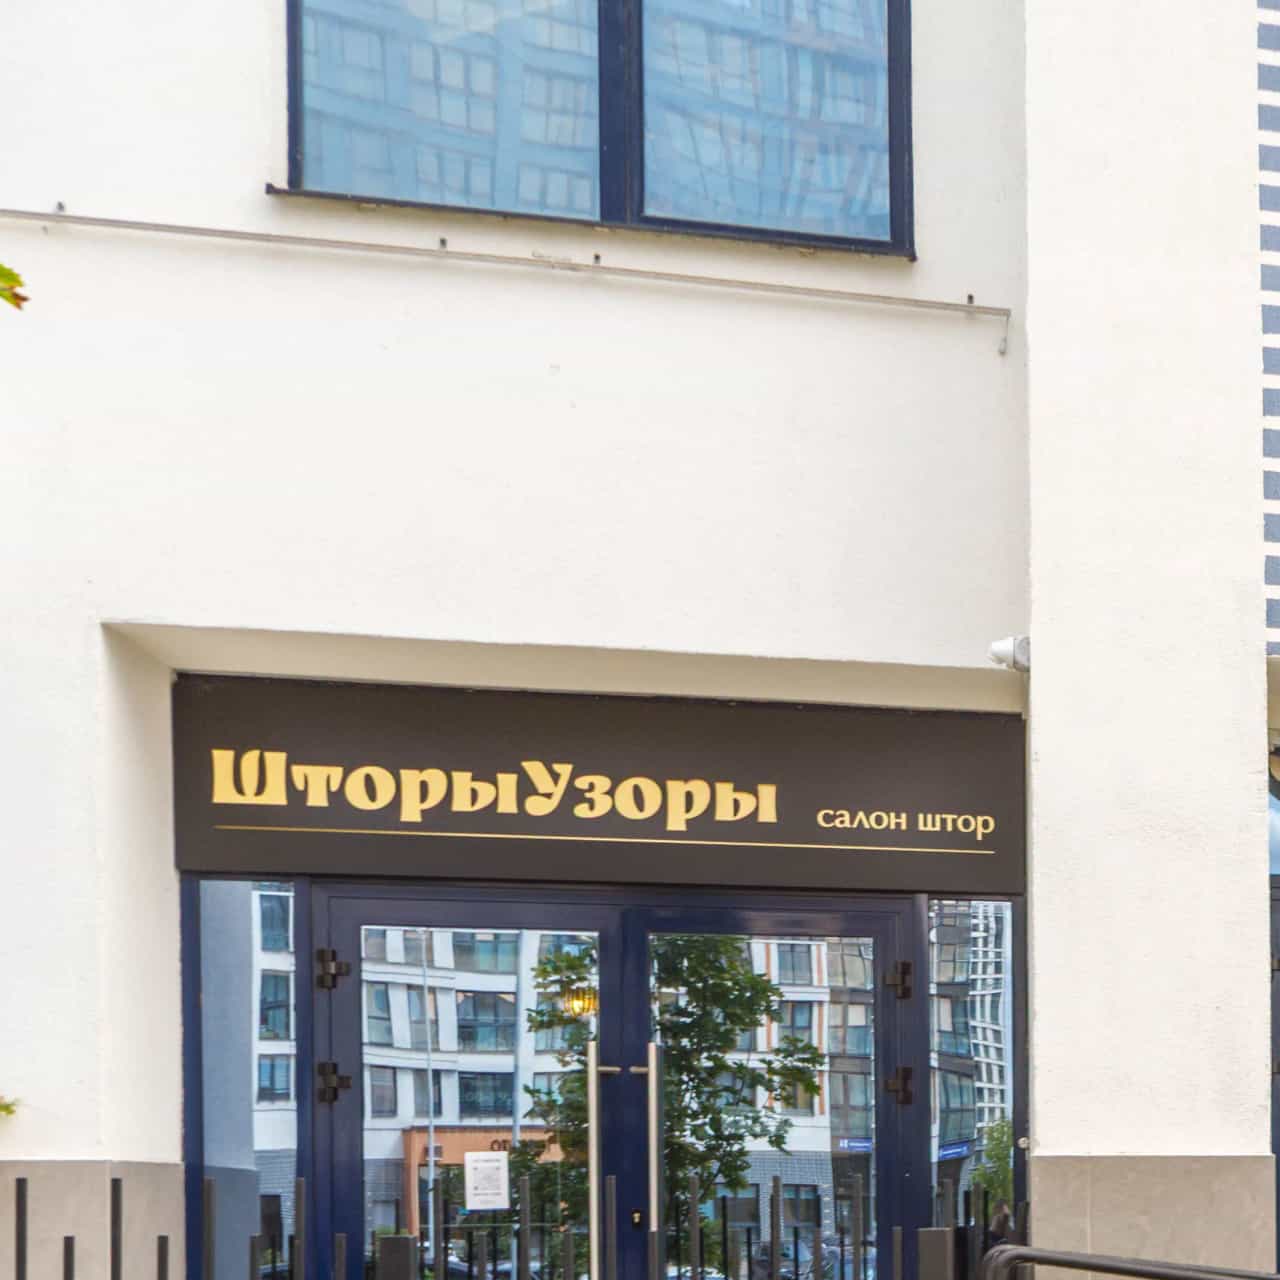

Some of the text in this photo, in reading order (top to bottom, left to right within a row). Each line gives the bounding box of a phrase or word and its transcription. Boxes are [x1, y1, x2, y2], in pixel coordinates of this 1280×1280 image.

[211, 748, 996, 841] ШторыУзоры салон штор
